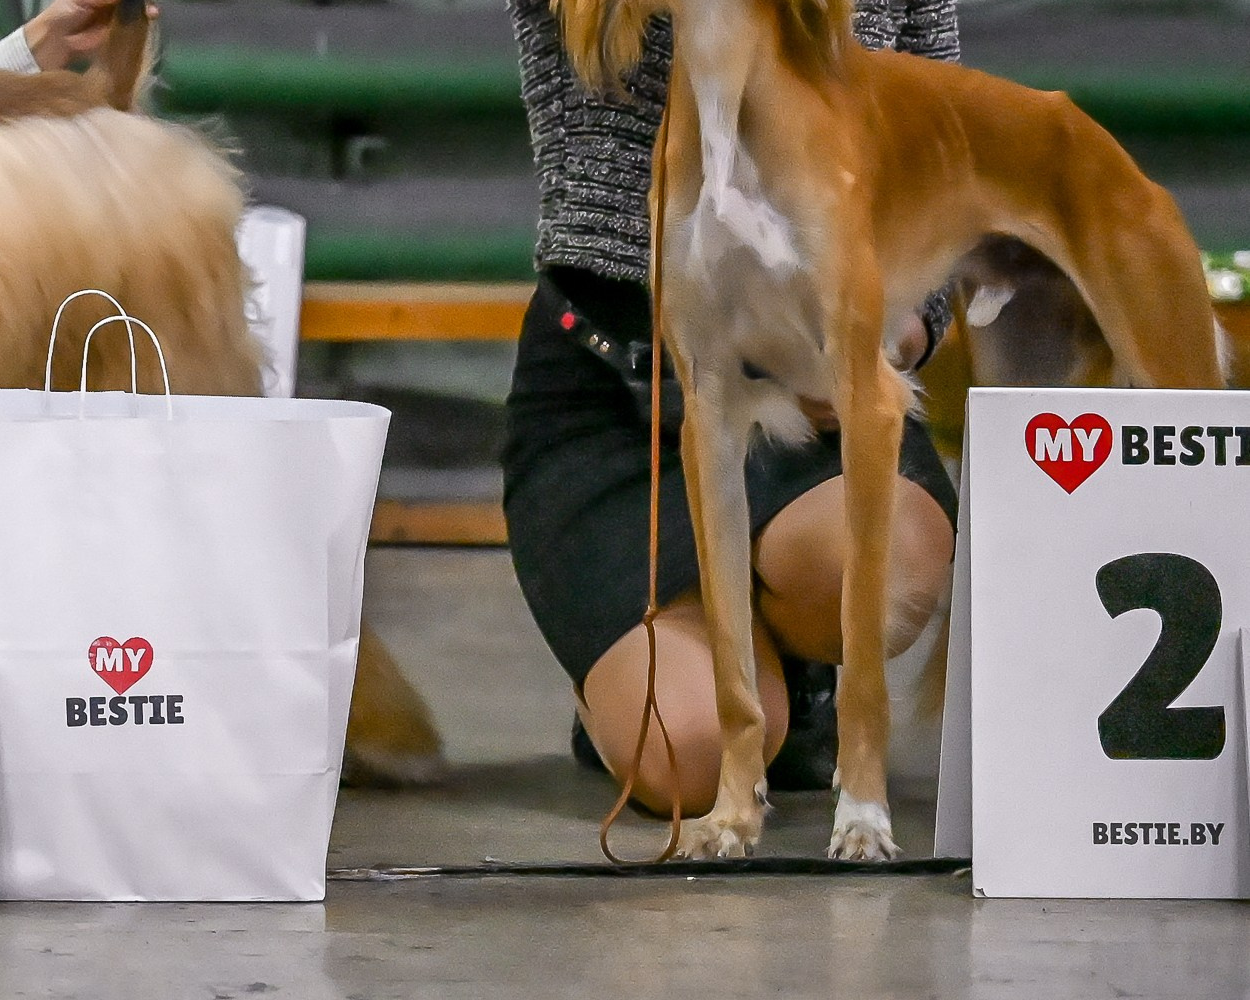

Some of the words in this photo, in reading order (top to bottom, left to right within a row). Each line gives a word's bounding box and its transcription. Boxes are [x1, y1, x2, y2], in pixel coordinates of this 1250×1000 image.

[1035, 428, 1103, 462] MY
[1121, 425, 1250, 466] BESTI
[95, 647, 147, 672] MY
[1095, 552, 1227, 760] 2
[66, 694, 184, 728] BESTIE
[1092, 822, 1225, 846] BESTIE.BY
